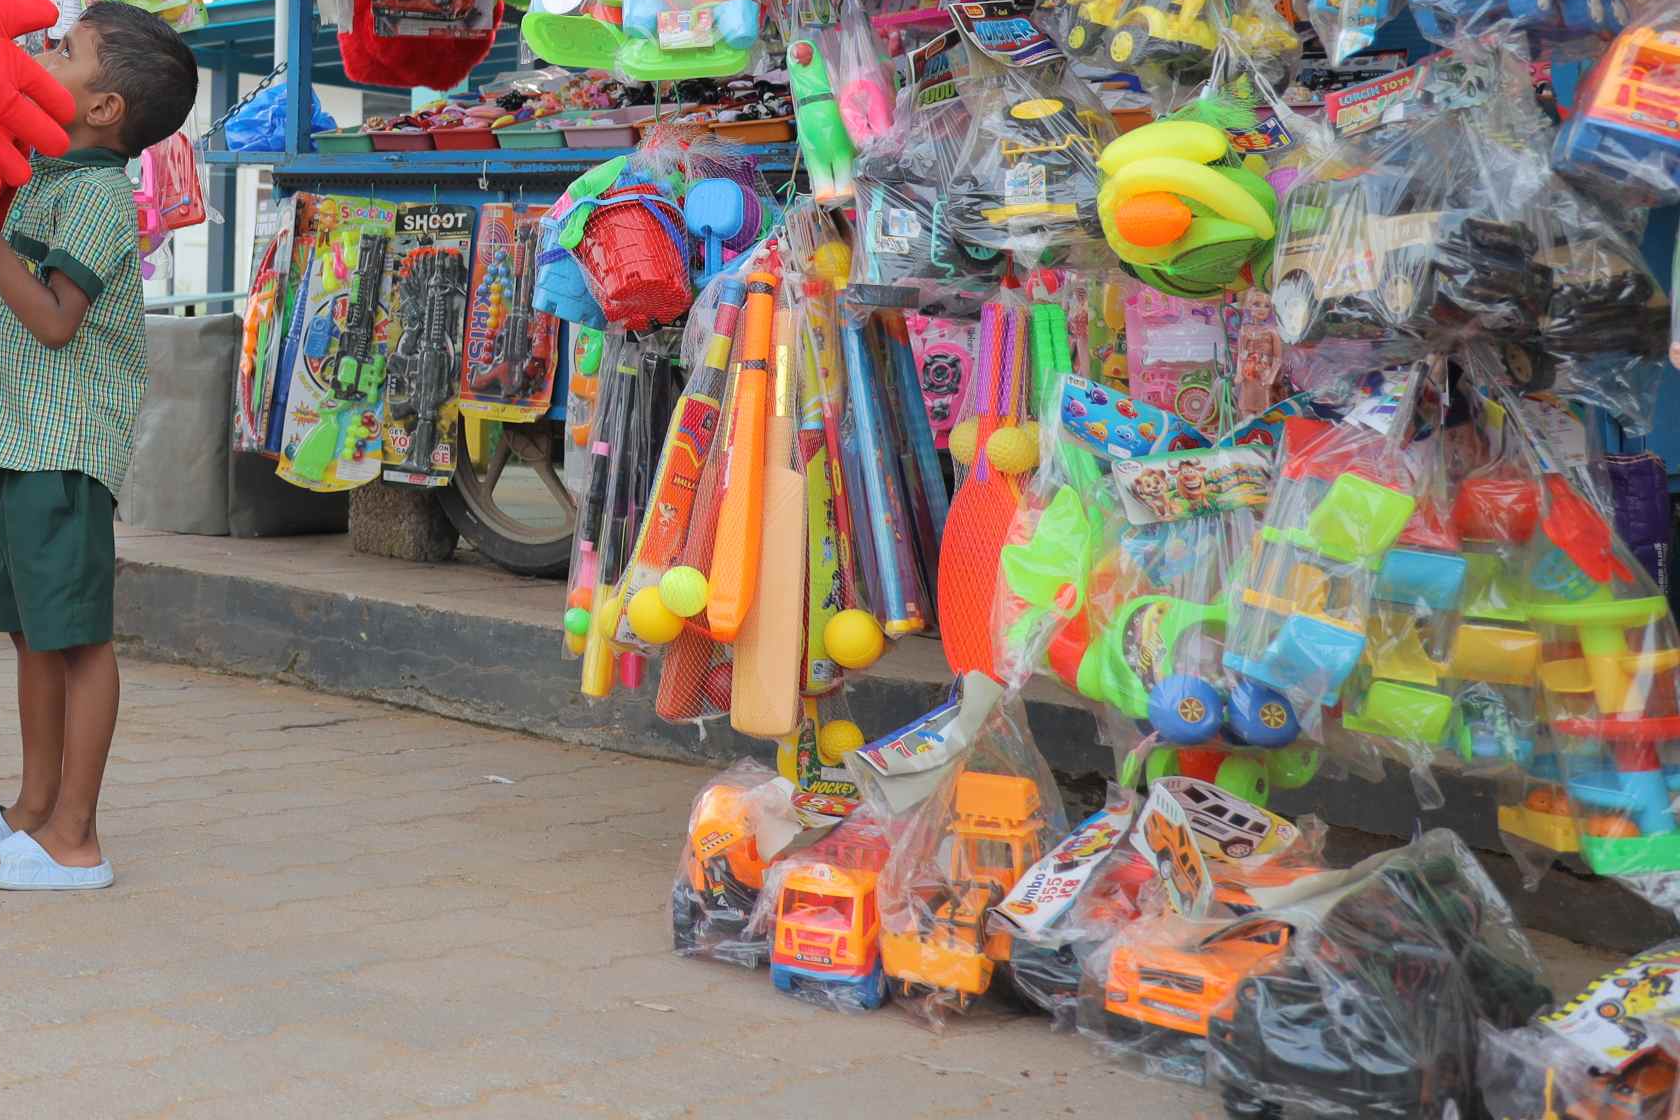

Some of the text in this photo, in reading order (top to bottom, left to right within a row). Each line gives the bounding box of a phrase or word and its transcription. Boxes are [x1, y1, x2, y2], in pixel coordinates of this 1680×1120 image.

[403, 212, 468, 231] SHOOT
[809, 781, 856, 794] HOCKEY
[1008, 873, 1046, 914] Jumbo
